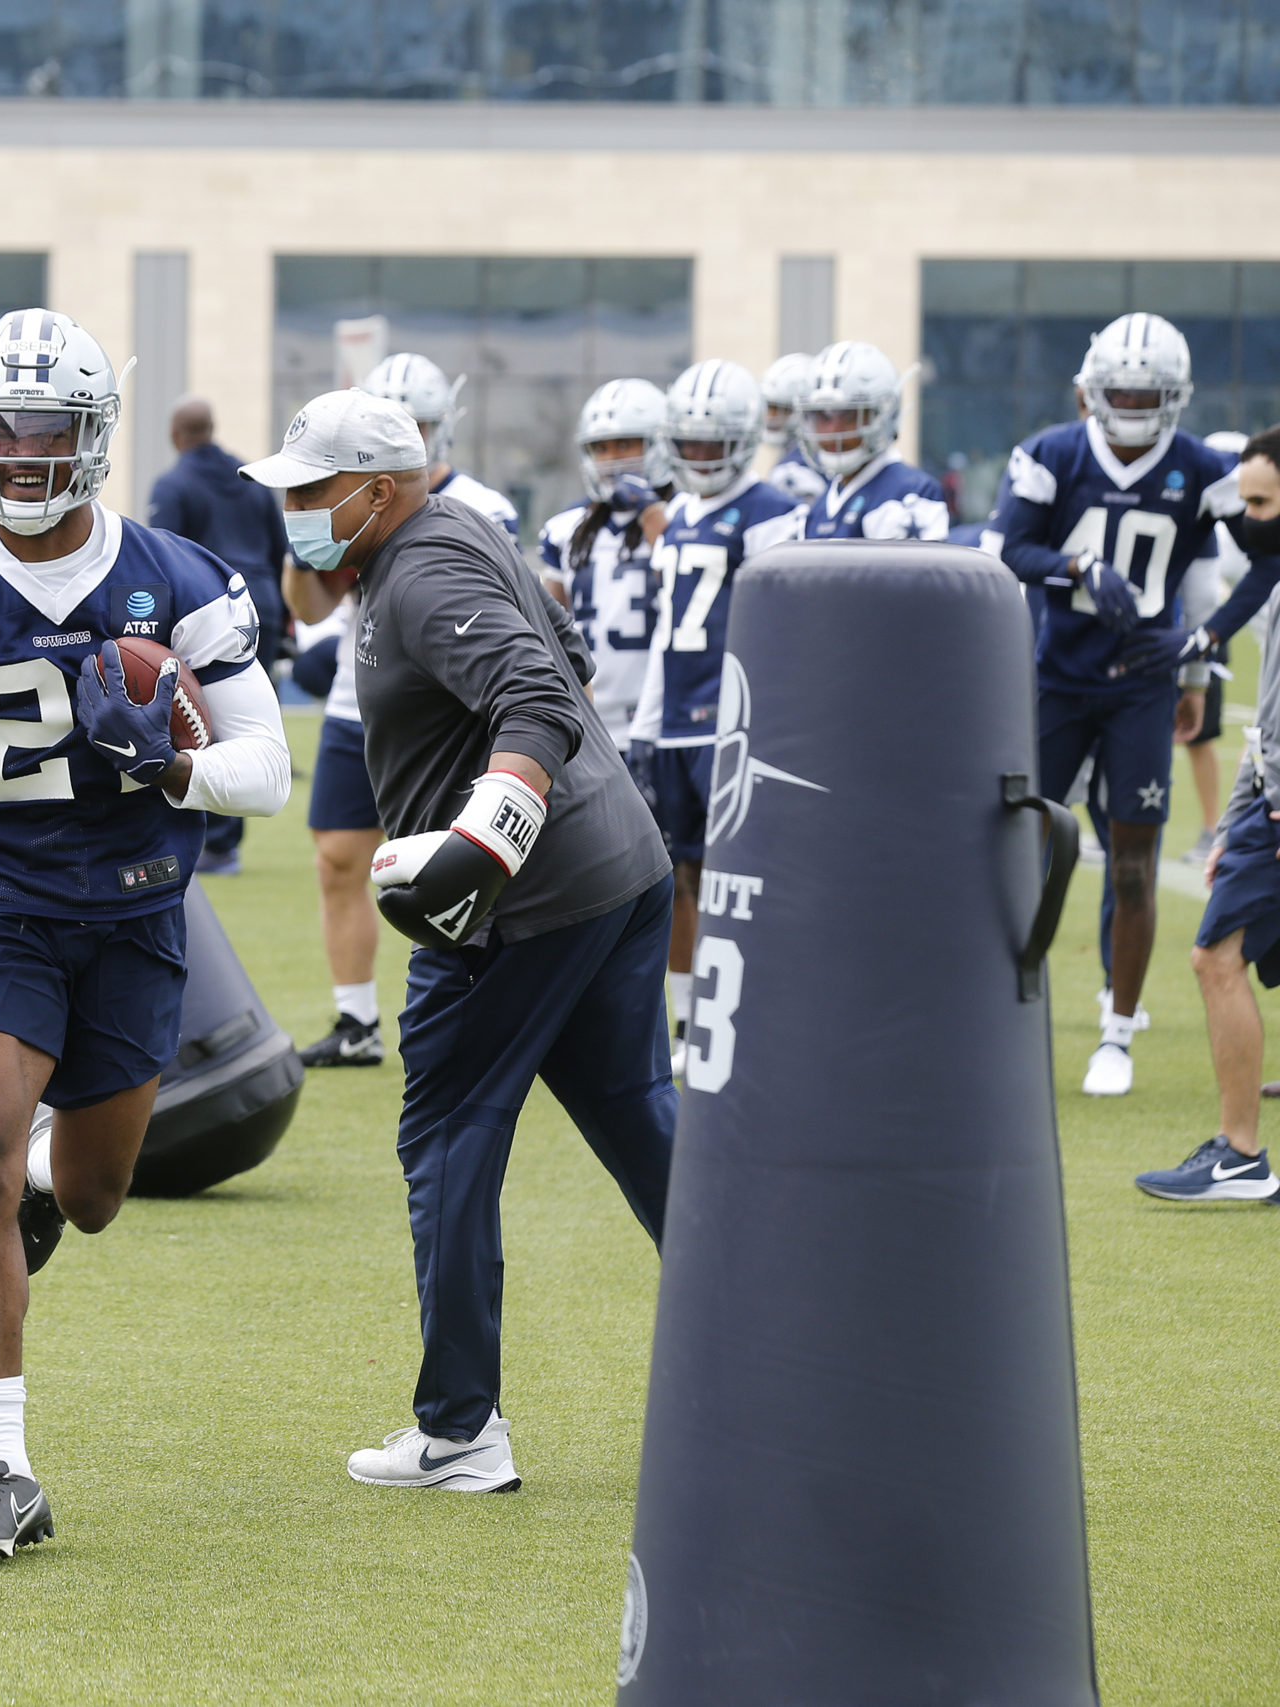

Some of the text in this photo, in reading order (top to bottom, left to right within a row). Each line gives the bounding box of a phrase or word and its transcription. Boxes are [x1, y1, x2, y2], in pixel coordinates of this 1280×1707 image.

[2, 341, 59, 355] JOSEPH
[9, 388, 45, 396] COWBOYS
[1060, 506, 1178, 618] 40
[123, 621, 159, 635] AT&T
[33, 631, 91, 648] COWBOYS
[496, 804, 536, 856] TITLE
[687, 935, 745, 1094] 3
